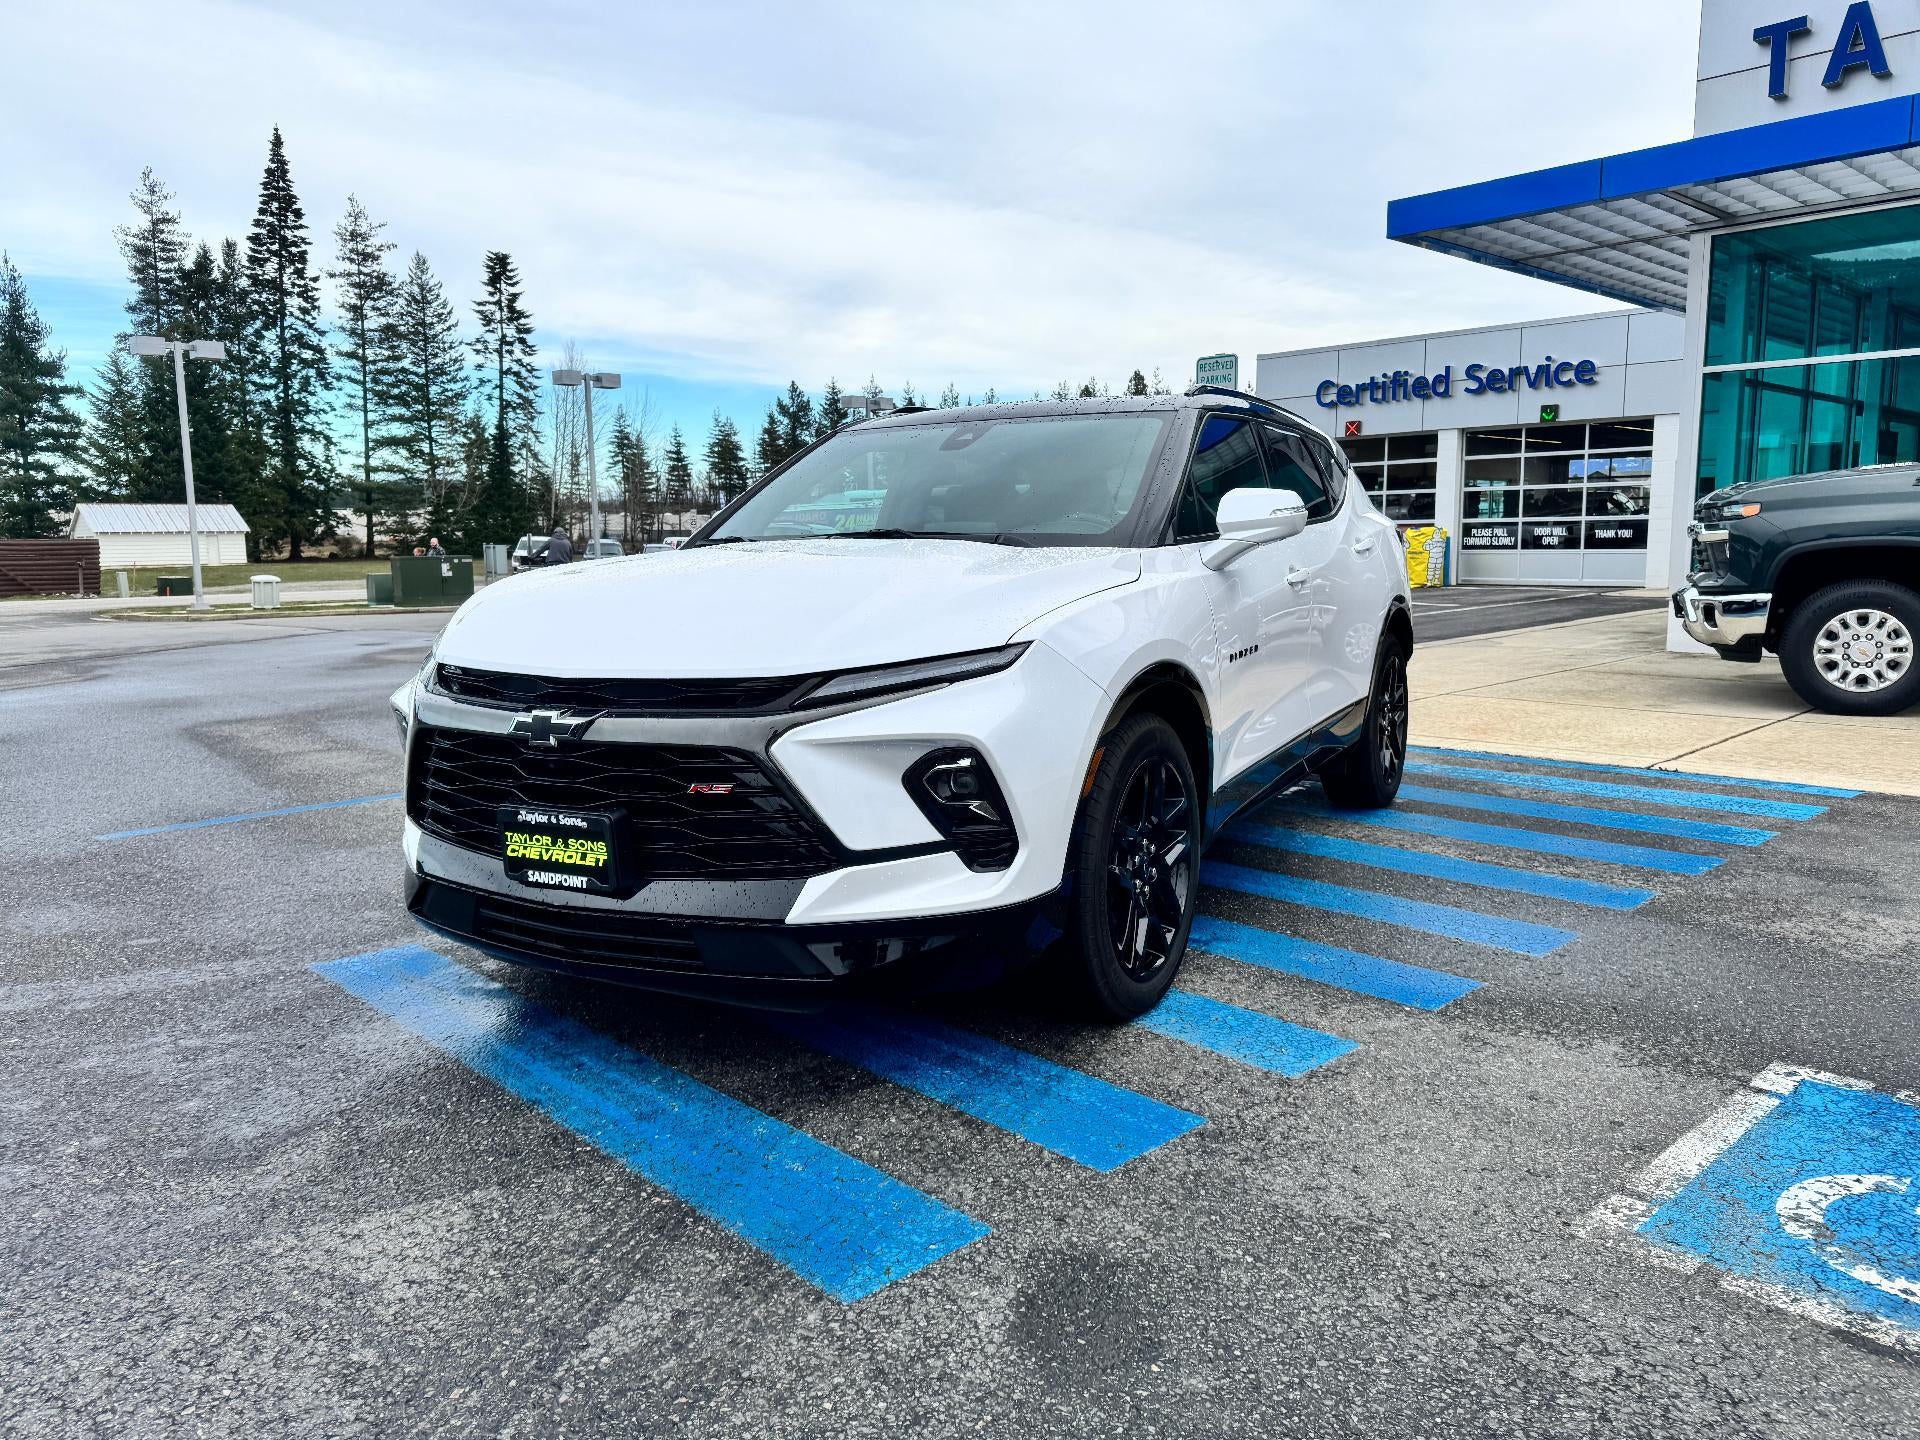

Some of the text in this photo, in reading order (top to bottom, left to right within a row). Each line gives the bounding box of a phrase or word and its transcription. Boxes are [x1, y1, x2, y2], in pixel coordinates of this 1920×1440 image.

[1199, 360, 1234, 372] RESERVED
[1200, 373, 1232, 385] PARKING
[1315, 355, 1597, 408] Certified Service
[1471, 528, 1508, 537] PLEASE PULL
[1534, 527, 1567, 536] DOOR WILL
[1595, 529, 1633, 538] THANK YOU!
[1463, 537, 1515, 546] FORWARD SLOWLY
[1541, 536, 1559, 546] OPEN
[687, 783, 735, 794] RS
[520, 810, 549, 824] Taylor
[550, 815, 557, 824] &
[505, 832, 607, 853] TAYLOR & SONS
[506, 844, 608, 867] CHEVROLET
[527, 870, 588, 888] SANDPOINT
